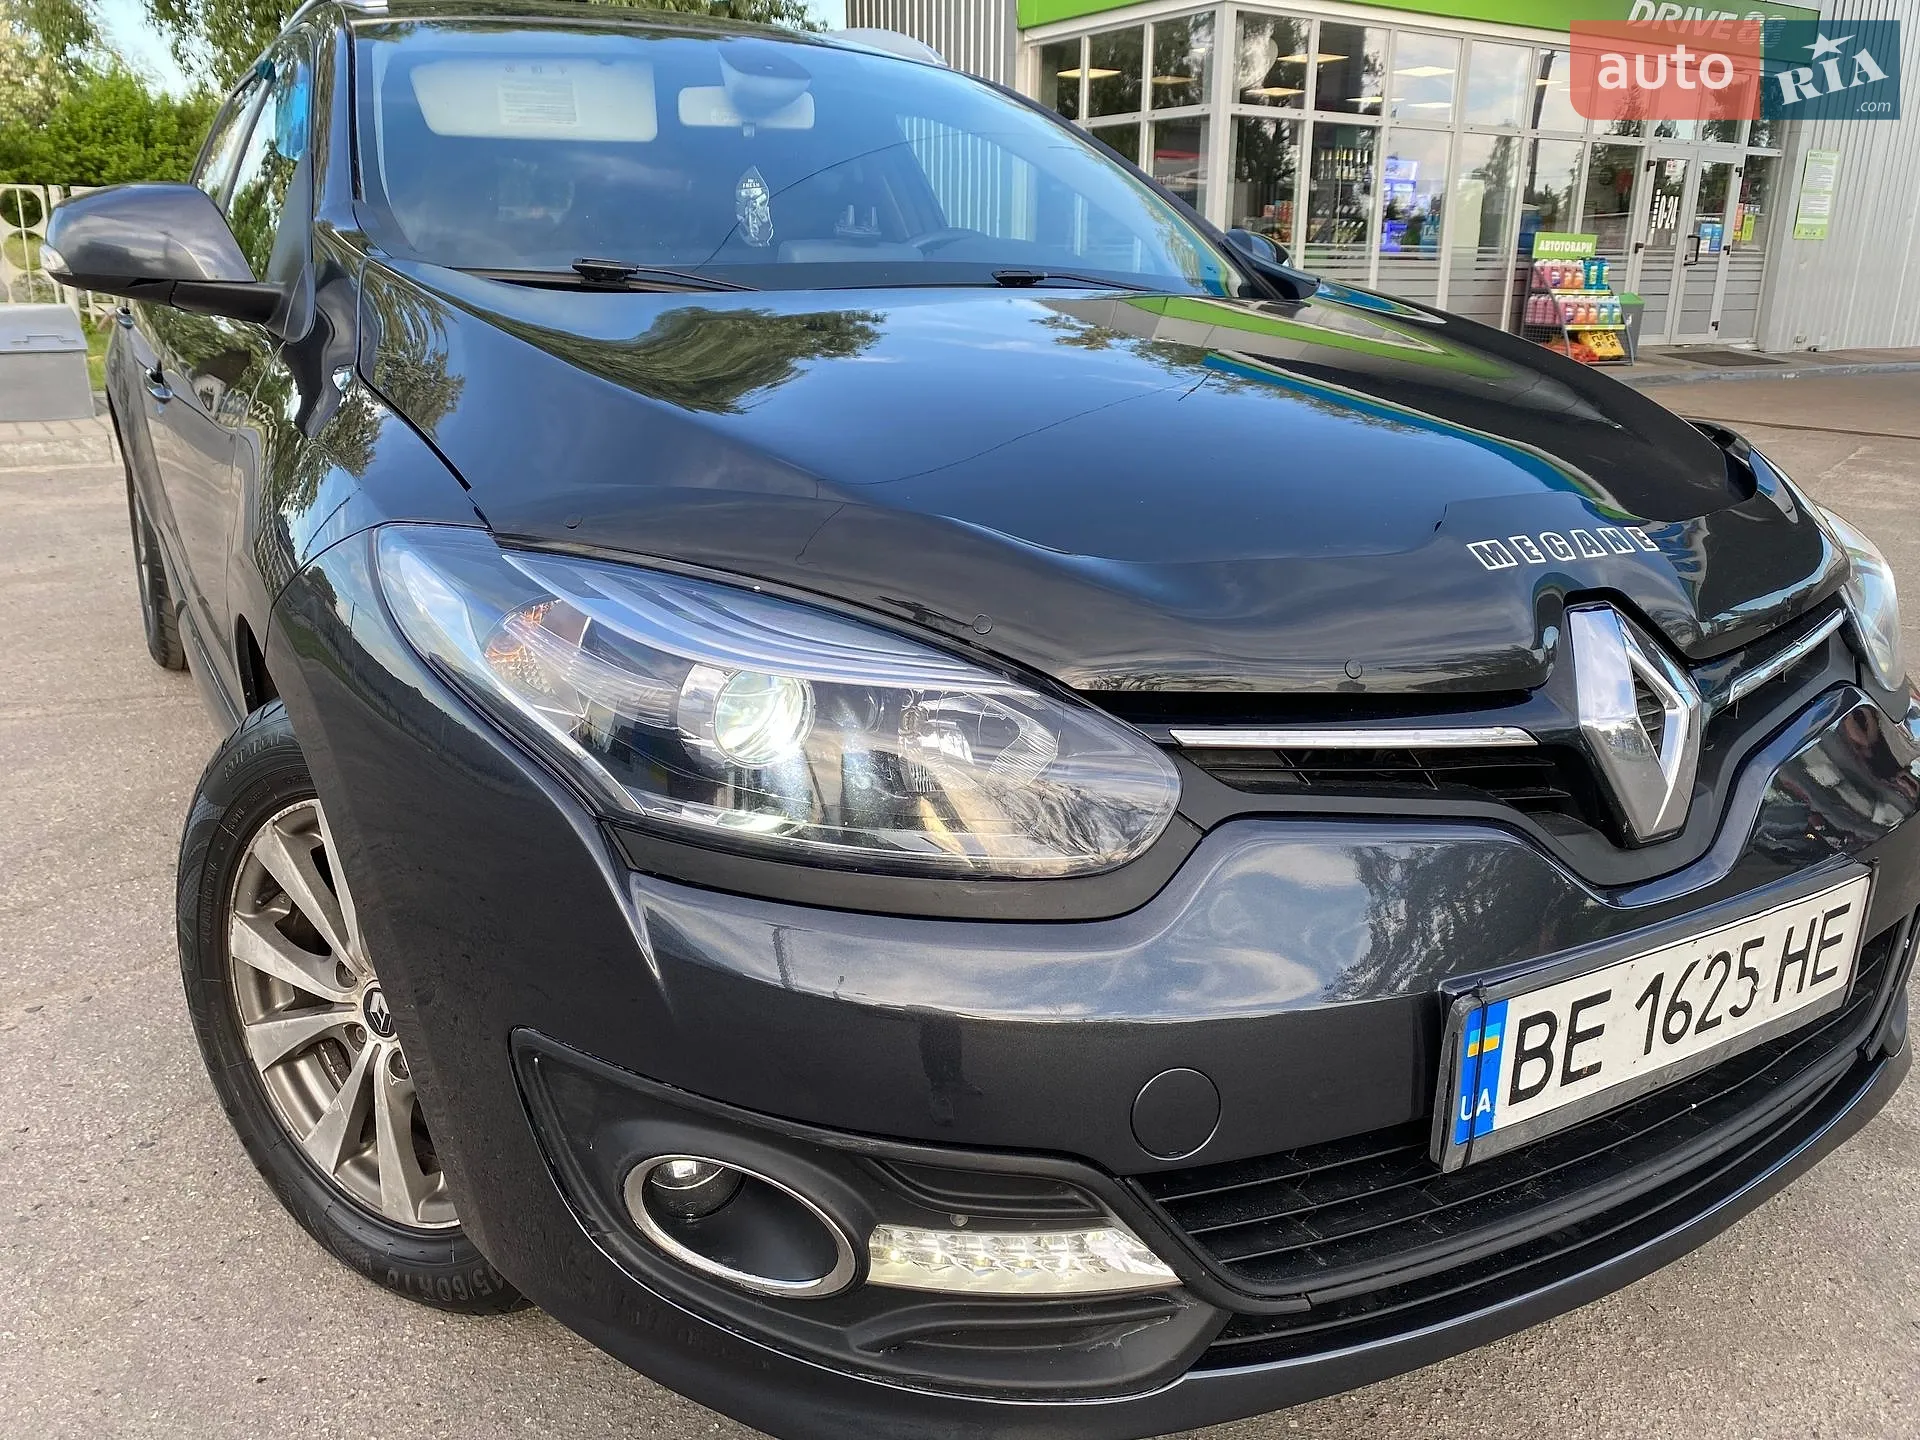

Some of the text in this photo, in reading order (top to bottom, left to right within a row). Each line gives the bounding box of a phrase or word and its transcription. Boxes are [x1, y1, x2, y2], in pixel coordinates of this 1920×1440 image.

[1626, 0, 1739, 40] DRIVE
[1538, 239, 1593, 253] АВТОТОВАРИ
[1466, 526, 1660, 570] MEGANE
[1508, 902, 1851, 1106] BE 1625 HE
[1460, 1086, 1492, 1122] UA
